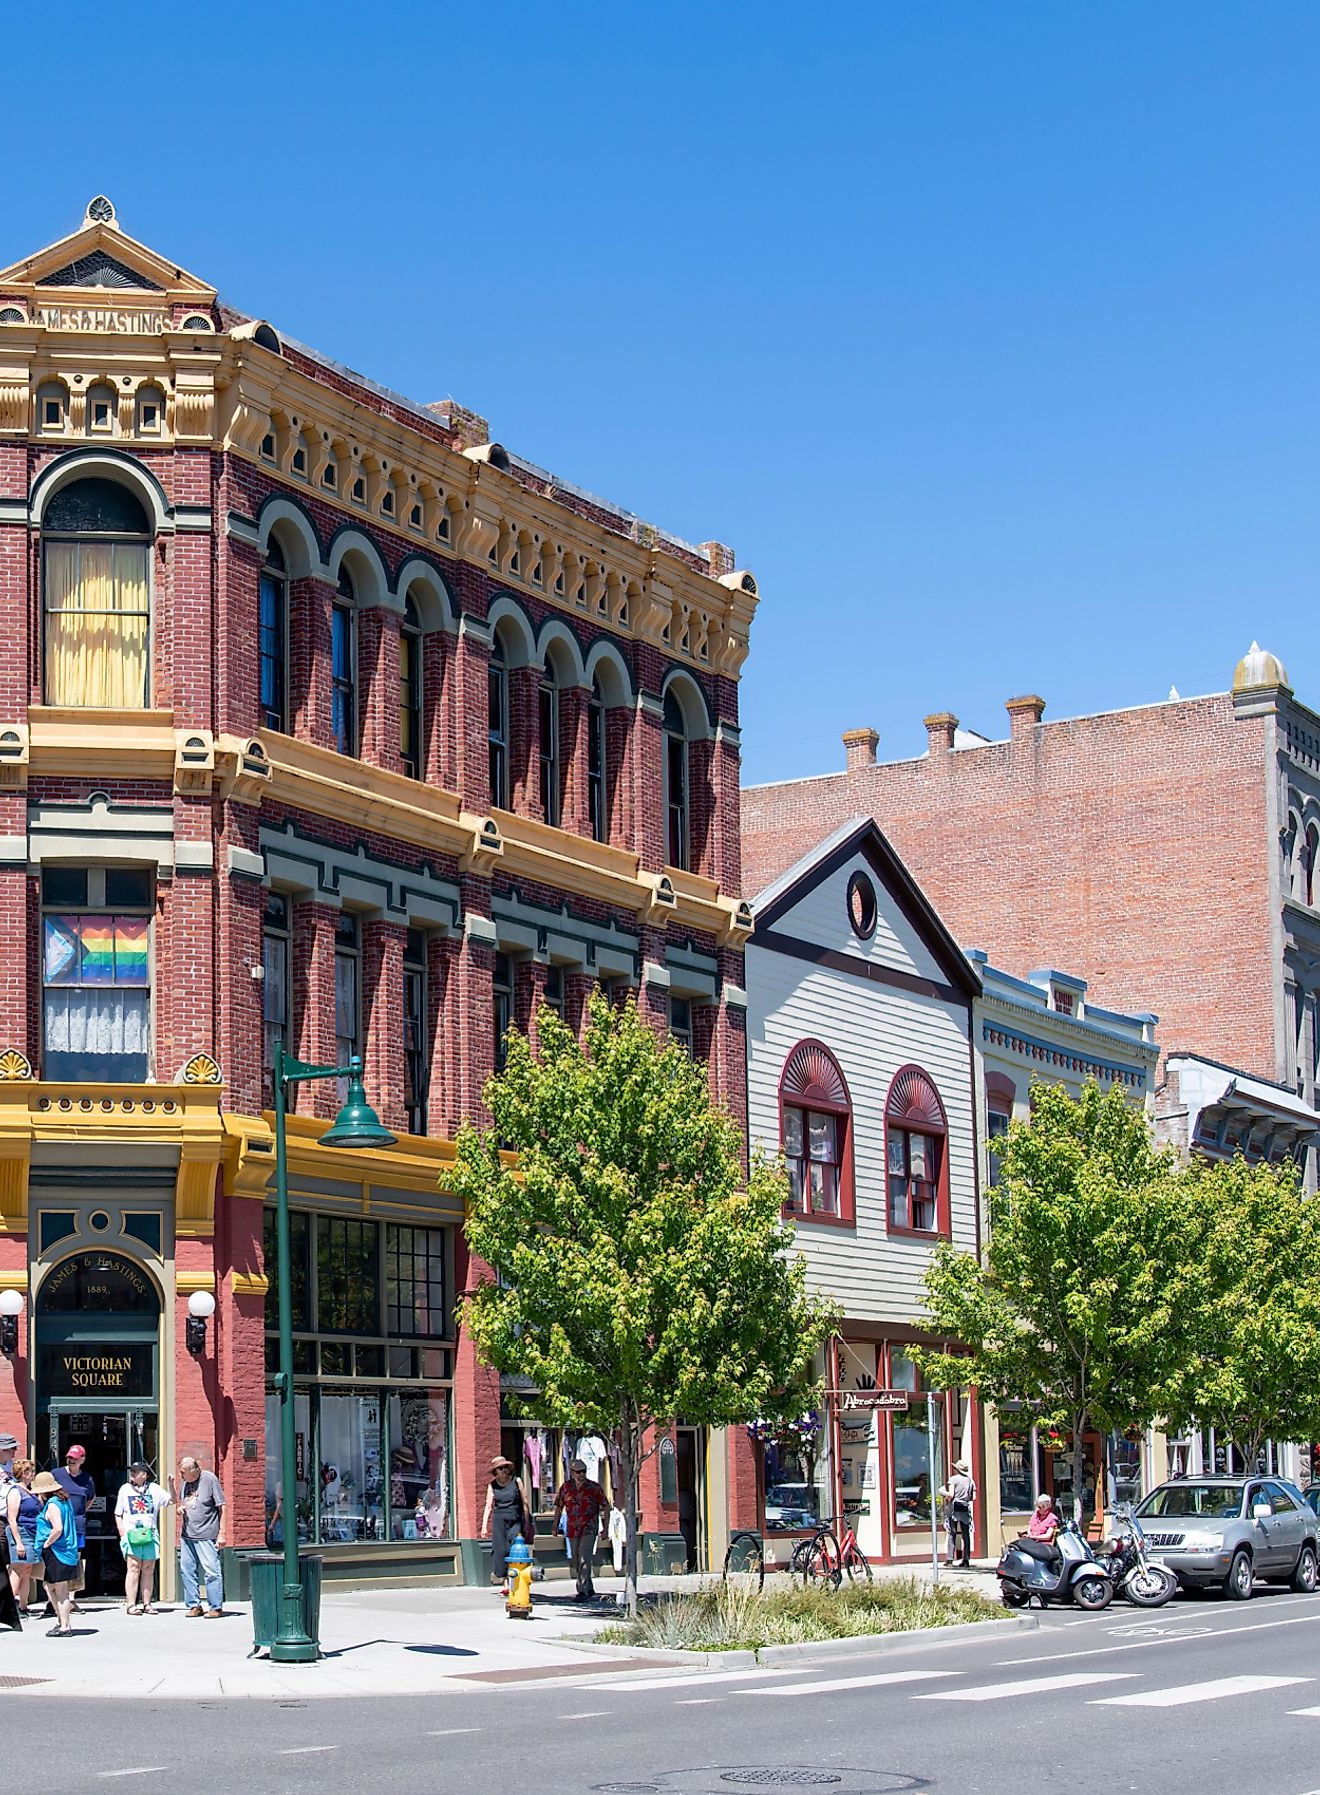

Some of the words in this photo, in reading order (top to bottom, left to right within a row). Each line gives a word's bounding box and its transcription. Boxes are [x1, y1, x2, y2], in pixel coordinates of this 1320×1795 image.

[95, 311, 172, 333] HASTINGS
[48, 1263, 78, 1293] JAMES
[63, 1357, 132, 1370] VICTORIAN
[71, 1372, 124, 1387] SQUARE
